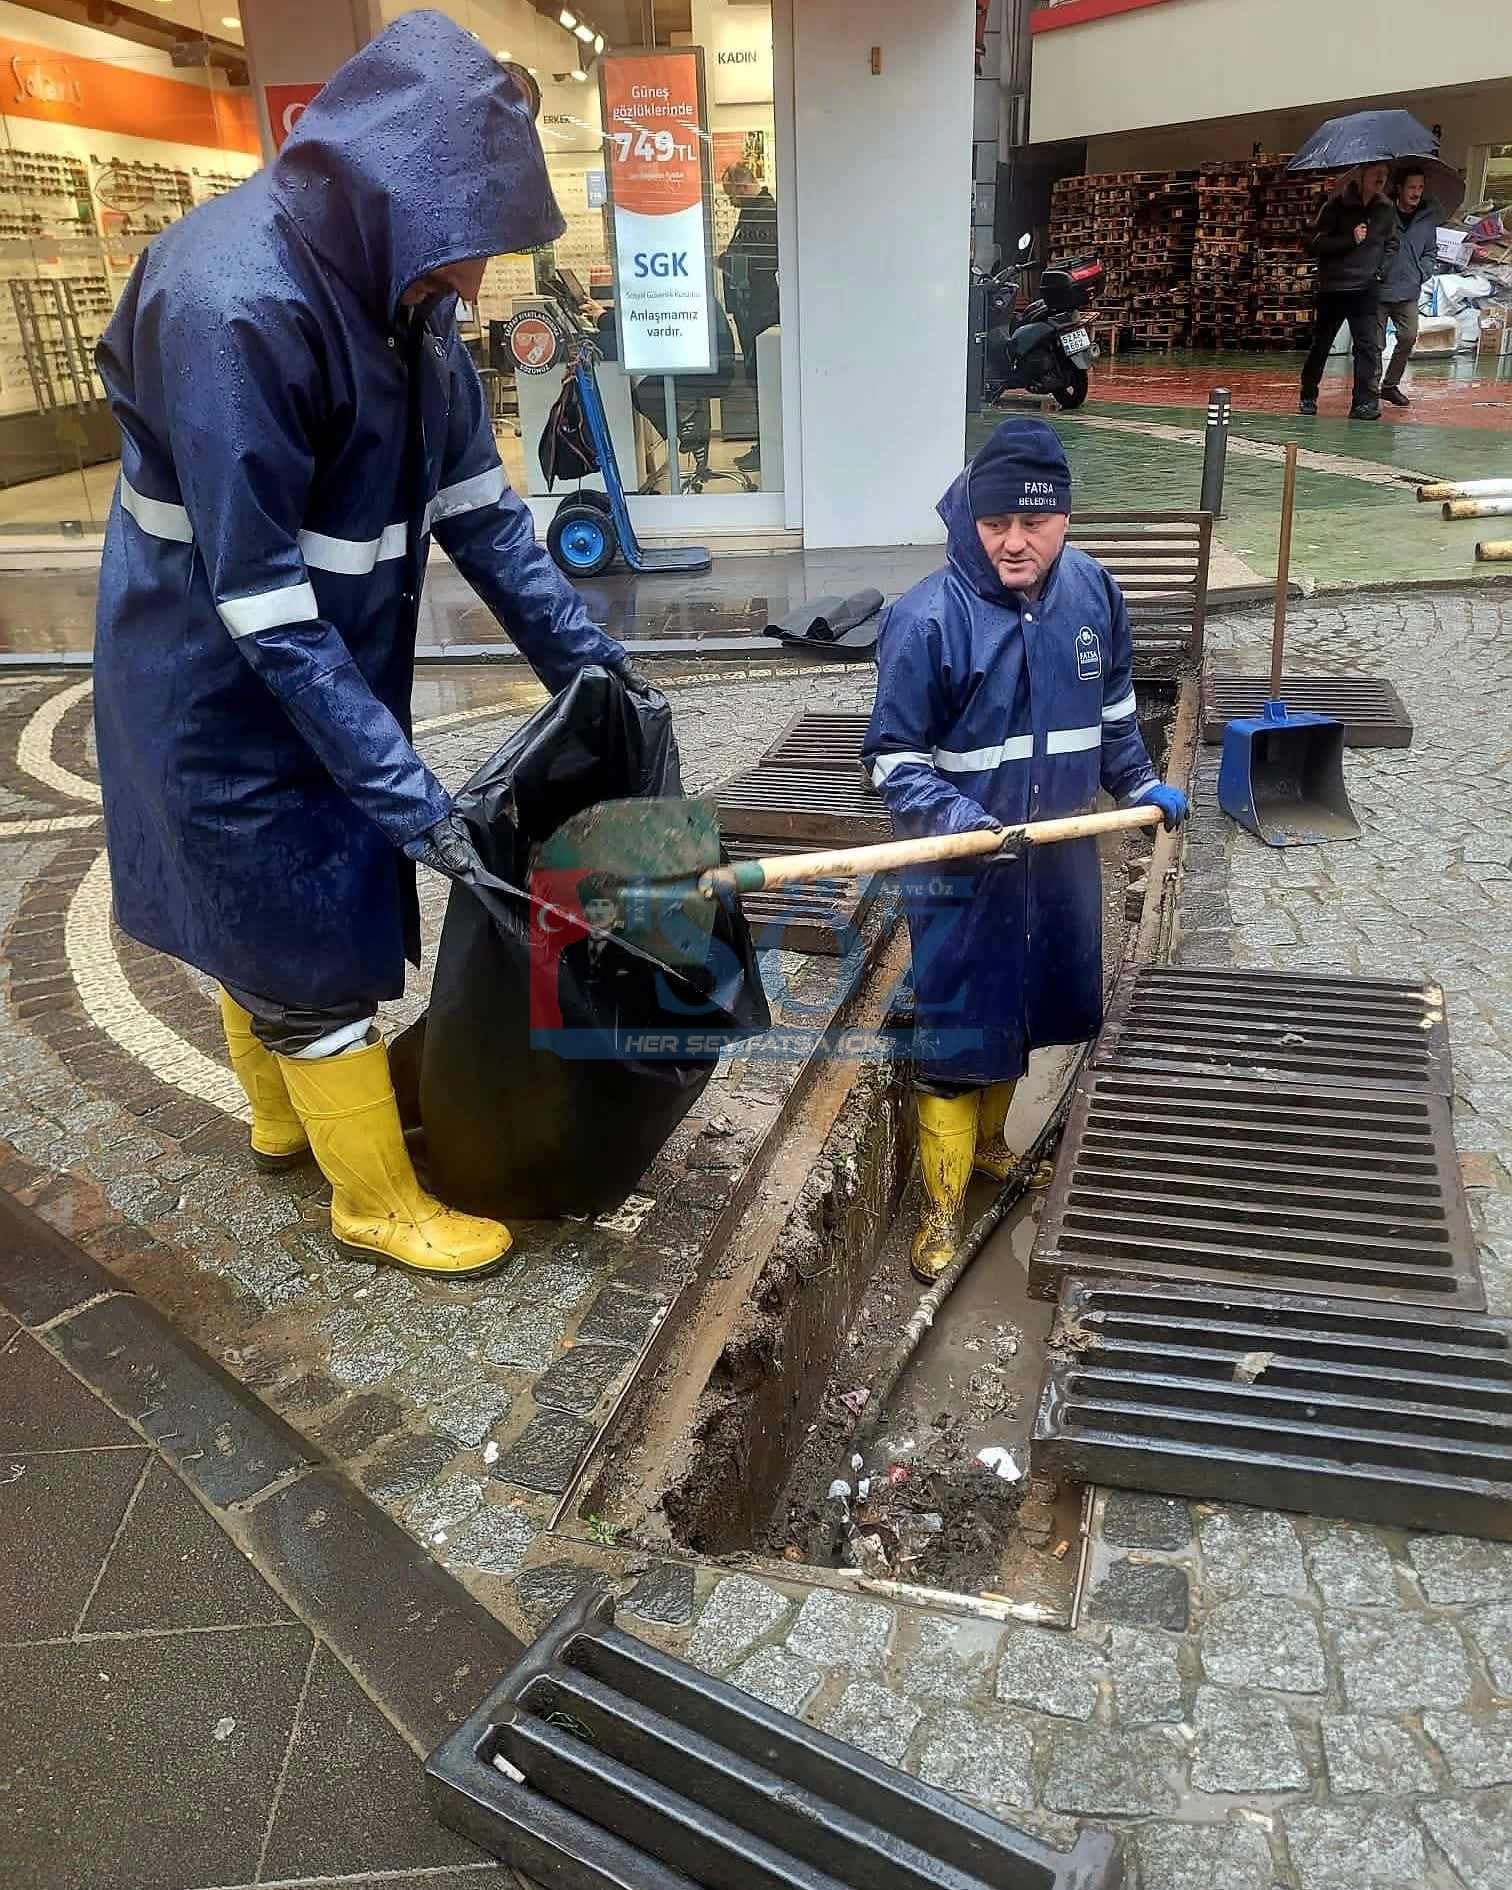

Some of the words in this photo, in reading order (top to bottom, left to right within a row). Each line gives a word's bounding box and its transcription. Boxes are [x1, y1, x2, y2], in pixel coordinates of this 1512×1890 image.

[718, 50, 757, 64] KADIN
[631, 85, 669, 100] Güneş
[613, 102, 693, 120] gözlüklerinde
[633, 251, 689, 278] SGK
[630, 308, 698, 324] Anlaşmamız
[647, 324, 683, 337] vardır.
[1024, 481, 1053, 494] FATSA
